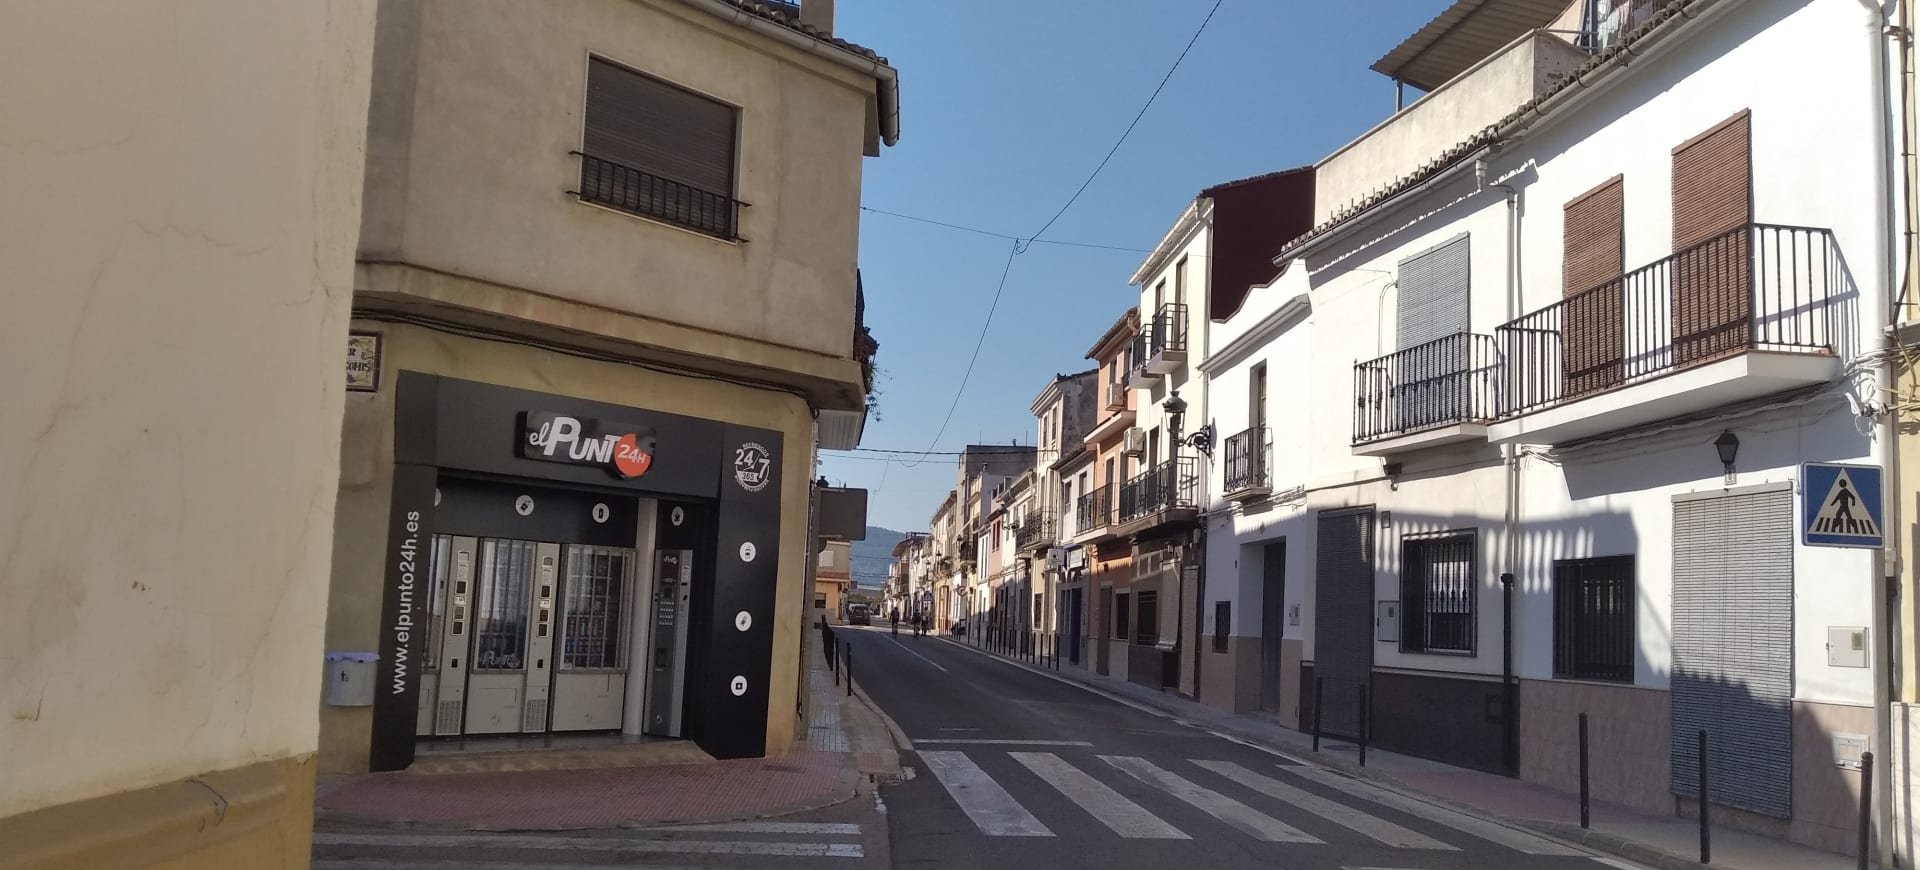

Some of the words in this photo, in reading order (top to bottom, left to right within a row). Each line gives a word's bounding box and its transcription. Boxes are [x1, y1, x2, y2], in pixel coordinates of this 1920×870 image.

[618, 444, 645, 463] 24H
[742, 472, 755, 481] 365
[393, 511, 419, 694] www.elpunto24h.es
